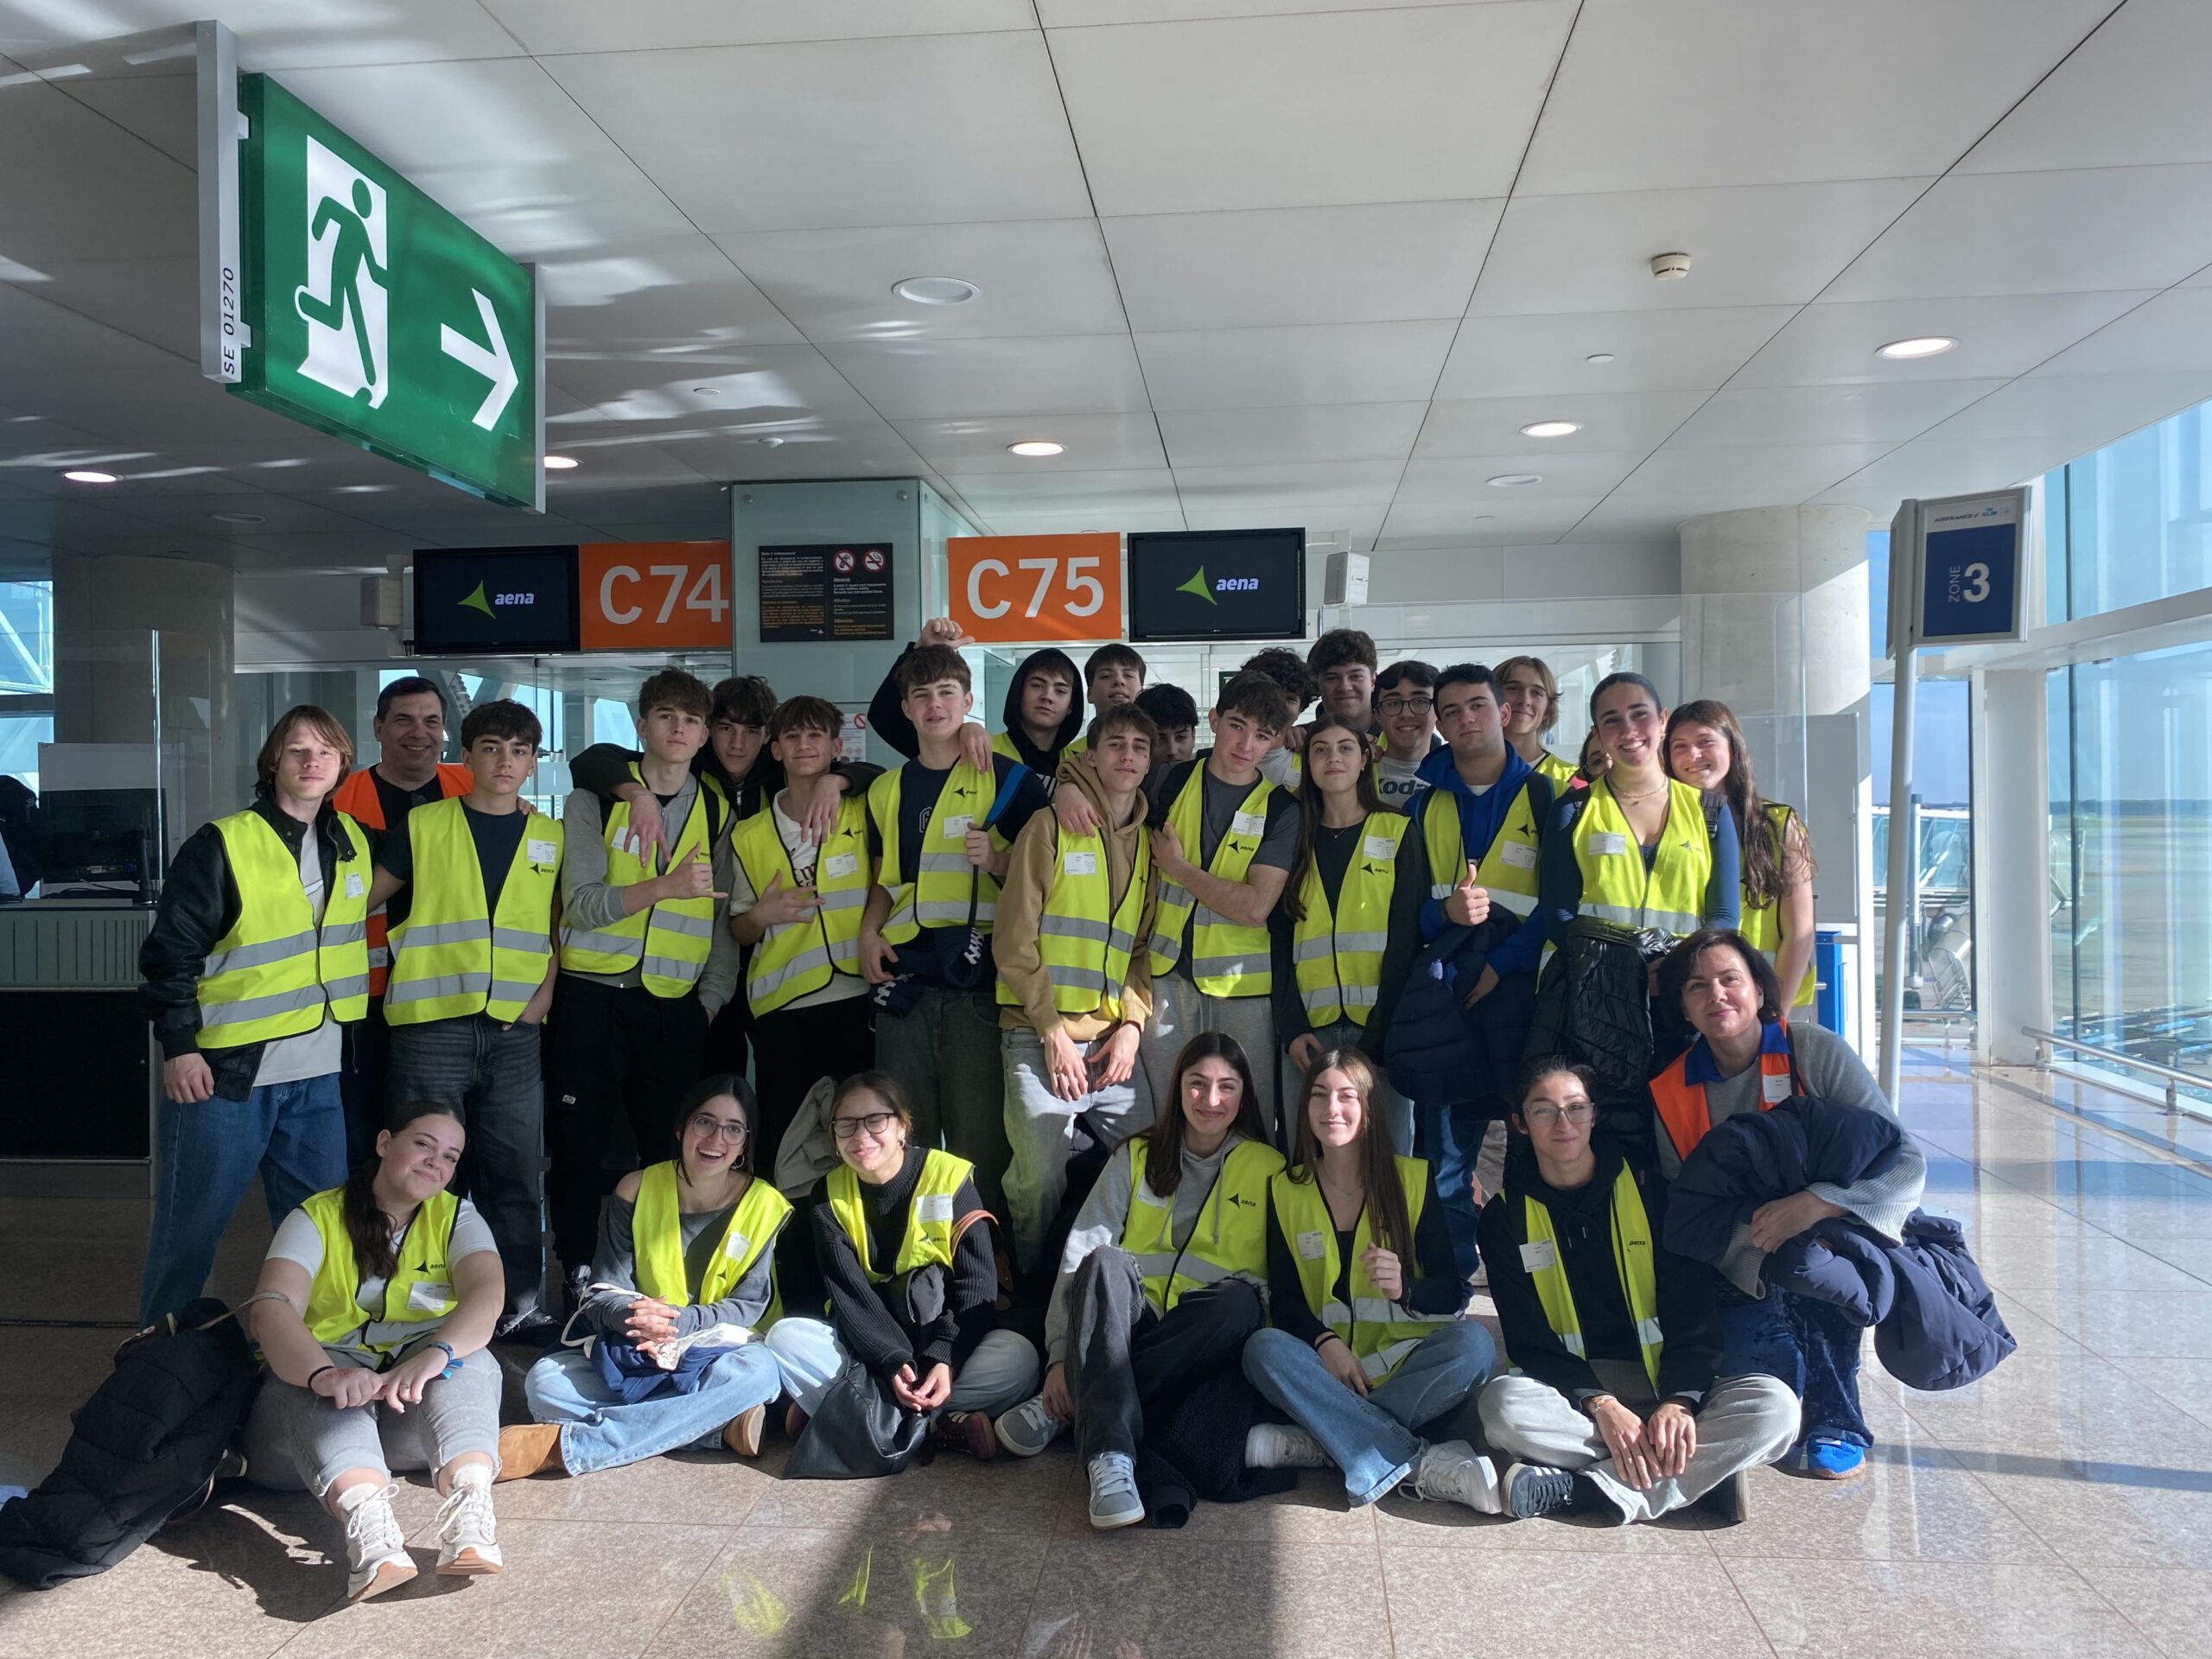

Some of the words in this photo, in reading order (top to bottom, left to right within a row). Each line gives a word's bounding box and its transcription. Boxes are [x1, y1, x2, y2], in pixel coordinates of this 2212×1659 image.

[223, 267, 234, 336] 01270
[224, 346, 235, 375] SE
[494, 592, 535, 605] aena
[600, 563, 729, 625] C74
[967, 556, 1104, 620] C75
[1216, 577, 1259, 591] aena
[1948, 565, 1961, 602] ZONE
[1963, 563, 1991, 602] 3
[1378, 779, 1427, 795] od
